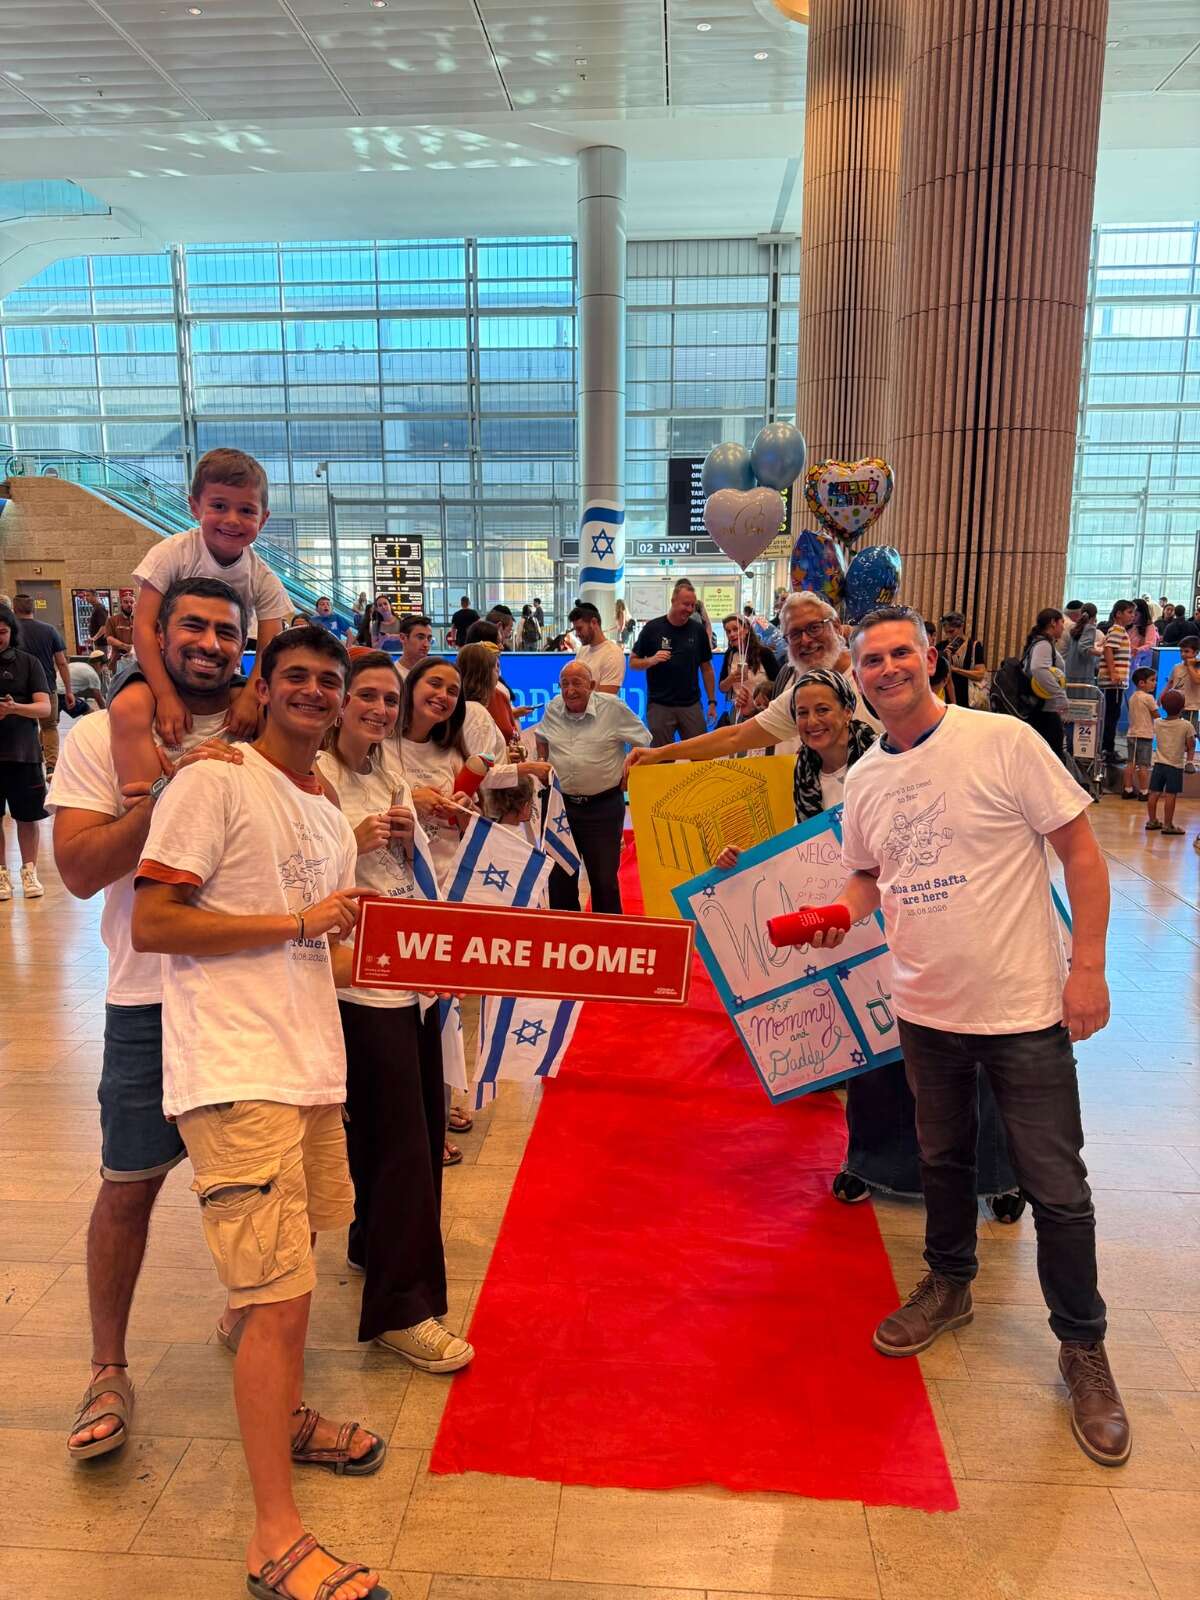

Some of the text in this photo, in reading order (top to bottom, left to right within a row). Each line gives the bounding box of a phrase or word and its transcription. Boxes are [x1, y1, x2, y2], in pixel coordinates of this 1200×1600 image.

[640, 542, 690, 553] יציאה 02
[1079, 727, 1091, 735] 24
[796, 842, 842, 866] WELCOM
[911, 880, 931, 892] and
[933, 874, 968, 889] Safta
[902, 890, 949, 905] are here
[801, 911, 825, 927] JBL
[396, 931, 657, 975] WE ARE HOME!
[750, 988, 836, 1048] Mommy
[790, 1028, 810, 1042] and
